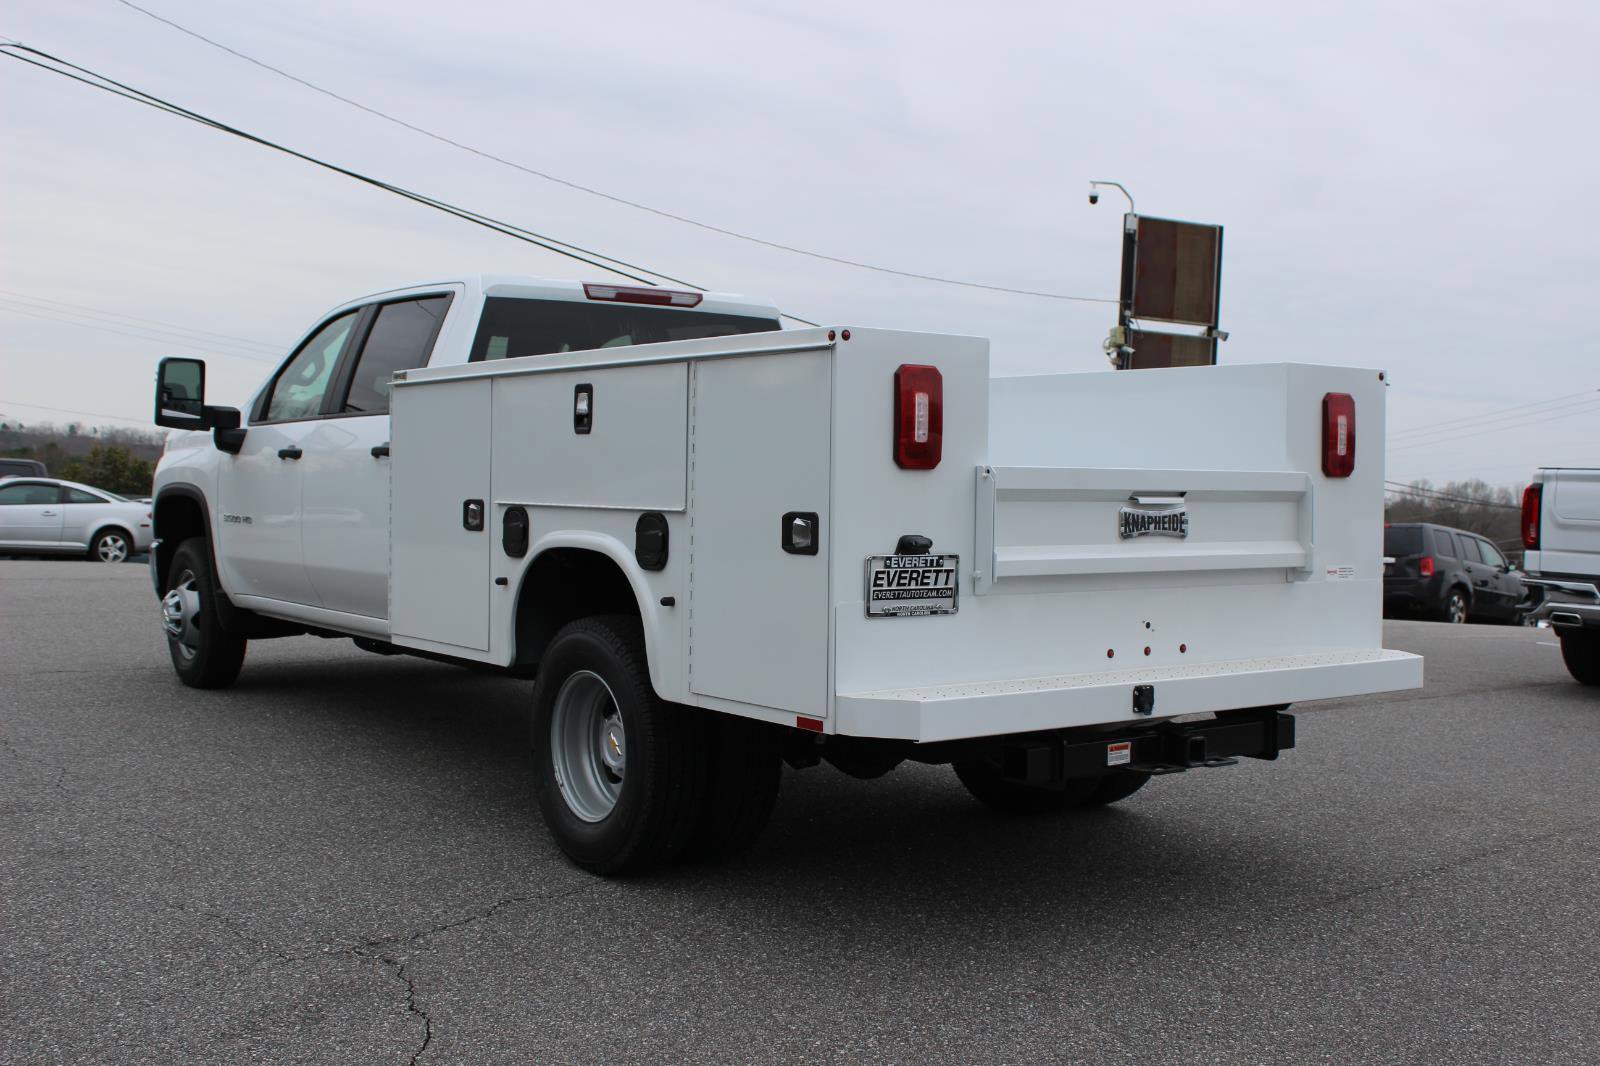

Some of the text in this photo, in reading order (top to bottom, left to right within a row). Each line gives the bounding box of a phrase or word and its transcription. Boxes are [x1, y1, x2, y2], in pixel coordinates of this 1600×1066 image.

[1123, 511, 1186, 534] KNAPHEIDE
[891, 556, 939, 568] EVERETT
[872, 569, 955, 587] EVERETT
[873, 590, 952, 599] EVERETTAUTOTEAM.COM
